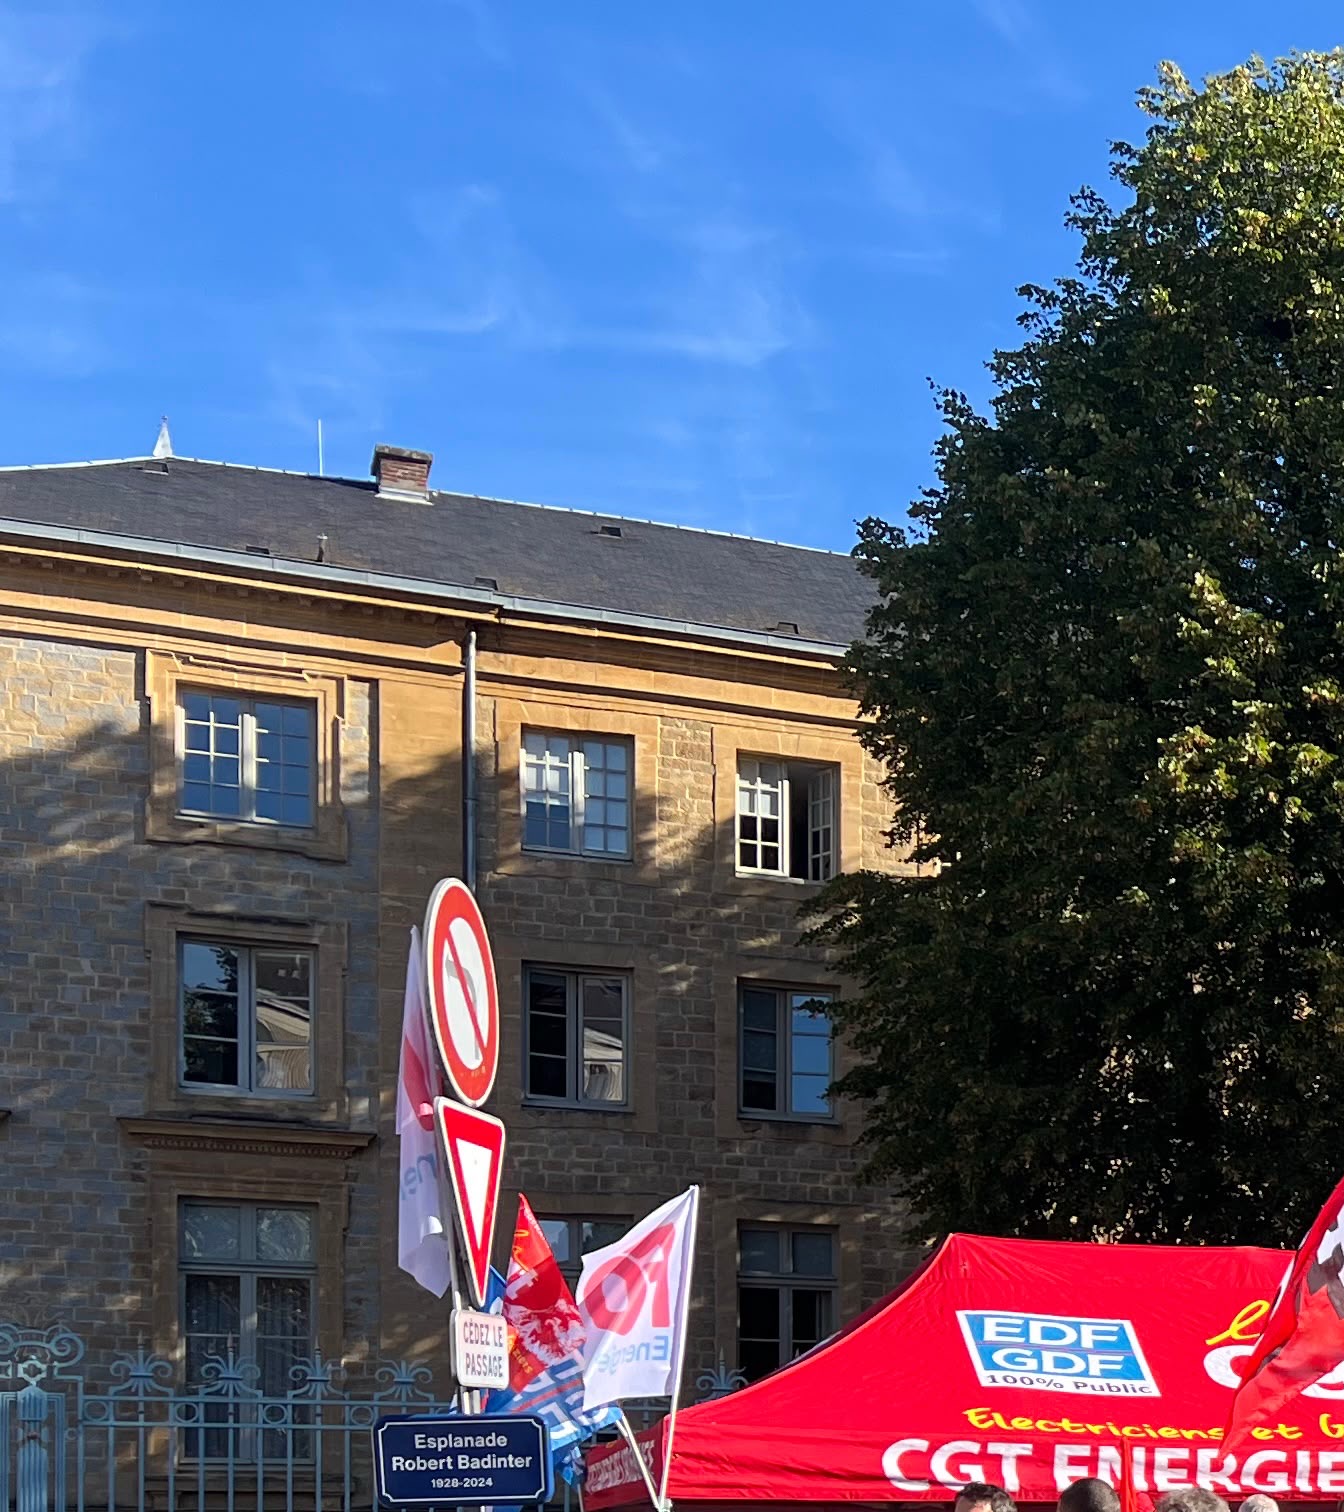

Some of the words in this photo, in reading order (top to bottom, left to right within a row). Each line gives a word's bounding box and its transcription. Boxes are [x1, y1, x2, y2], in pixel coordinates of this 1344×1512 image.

[463, 1318, 490, 1346] CÉDEZ
[493, 1325, 503, 1347] LE
[981, 1316, 1120, 1349] EDF
[465, 1352, 503, 1378] PASSAGE
[990, 1347, 1125, 1377] GDF
[985, 1374, 1064, 1390] 100%
[1072, 1380, 1153, 1395] Public
[962, 1405, 1225, 1440] Electriciens
[1251, 1423, 1302, 1440] et
[414, 1433, 508, 1452] Esplanade
[391, 1456, 453, 1471] Robert
[457, 1454, 532, 1470] Badinter
[881, 1438, 1033, 1494] CGT
[430, 1478, 493, 1489] 1928-2024
